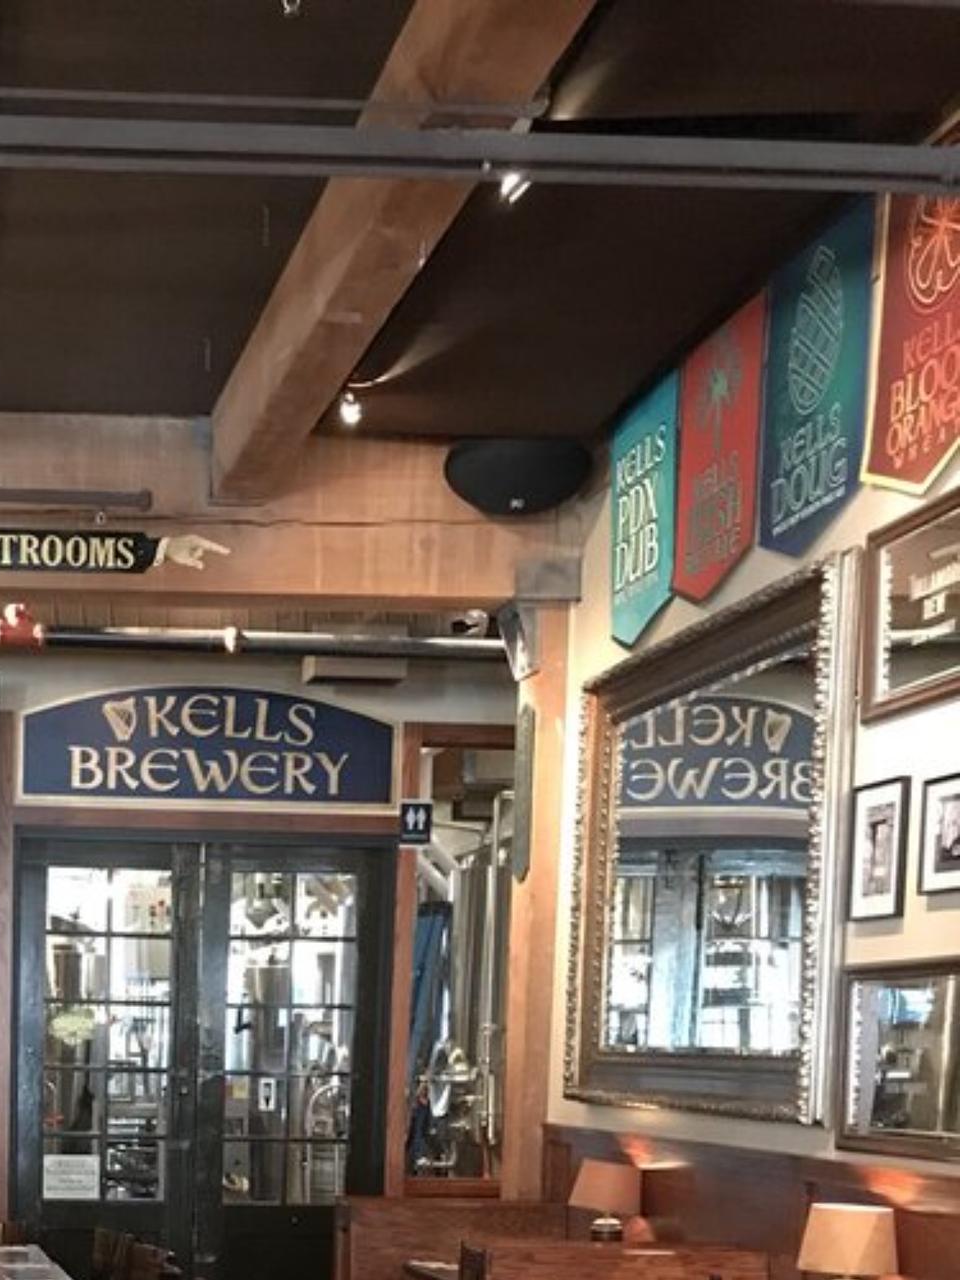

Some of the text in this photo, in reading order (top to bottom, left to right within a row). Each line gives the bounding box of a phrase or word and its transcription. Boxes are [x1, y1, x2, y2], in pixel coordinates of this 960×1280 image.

[903, 312, 960, 373] KELL
[891, 345, 960, 422] BLOO
[781, 402, 843, 478] KELLS
[886, 386, 960, 456] ORANG
[617, 425, 666, 493] KELLS
[770, 437, 848, 524] DOUG
[618, 470, 659, 544] PDX
[614, 522, 659, 593] DUB
[147, 694, 317, 747] KELLS
[68, 746, 349, 796] BREWERY
